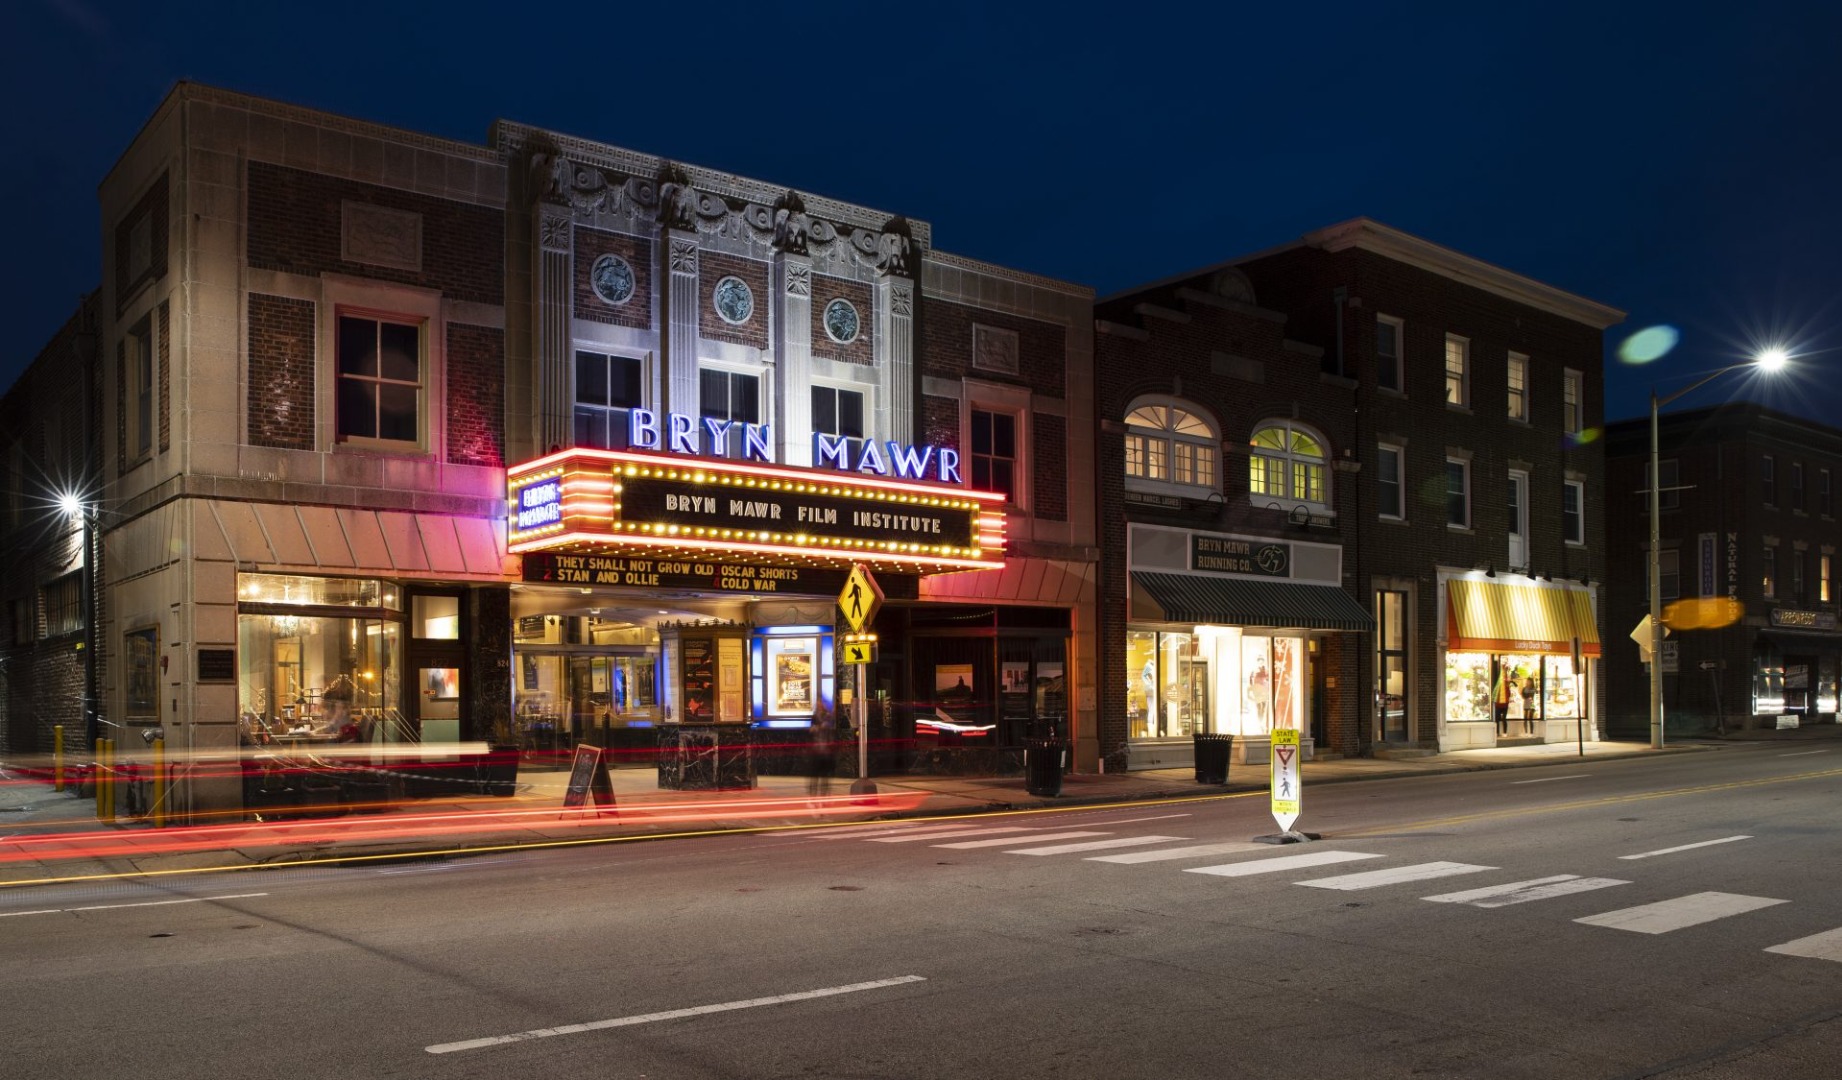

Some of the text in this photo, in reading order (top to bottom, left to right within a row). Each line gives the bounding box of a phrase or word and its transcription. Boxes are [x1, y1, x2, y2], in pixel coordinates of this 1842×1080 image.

[628, 408, 962, 483] BRYN MAWR
[666, 494, 941, 534] BRYN MAWR FILM INSTITUTE
[1198, 538, 1250, 555] BRYN MAWR
[555, 555, 588, 569] THEY
[588, 557, 626, 571] SHALL
[629, 560, 653, 573] NOT
[658, 562, 691, 575] GROW
[694, 563, 714, 576] OLD
[1197, 555, 1253, 572] RUNNING CO.
[557, 569, 590, 582] STAN
[596, 571, 619, 584] AND
[625, 572, 660, 585] OLLIE
[721, 565, 755, 577] OSCAR
[759, 567, 798, 580] SHORTS
[1727, 532, 1738, 621] NATURAL FOODS
[721, 577, 749, 590] COLD
[753, 580, 776, 591] WAR
